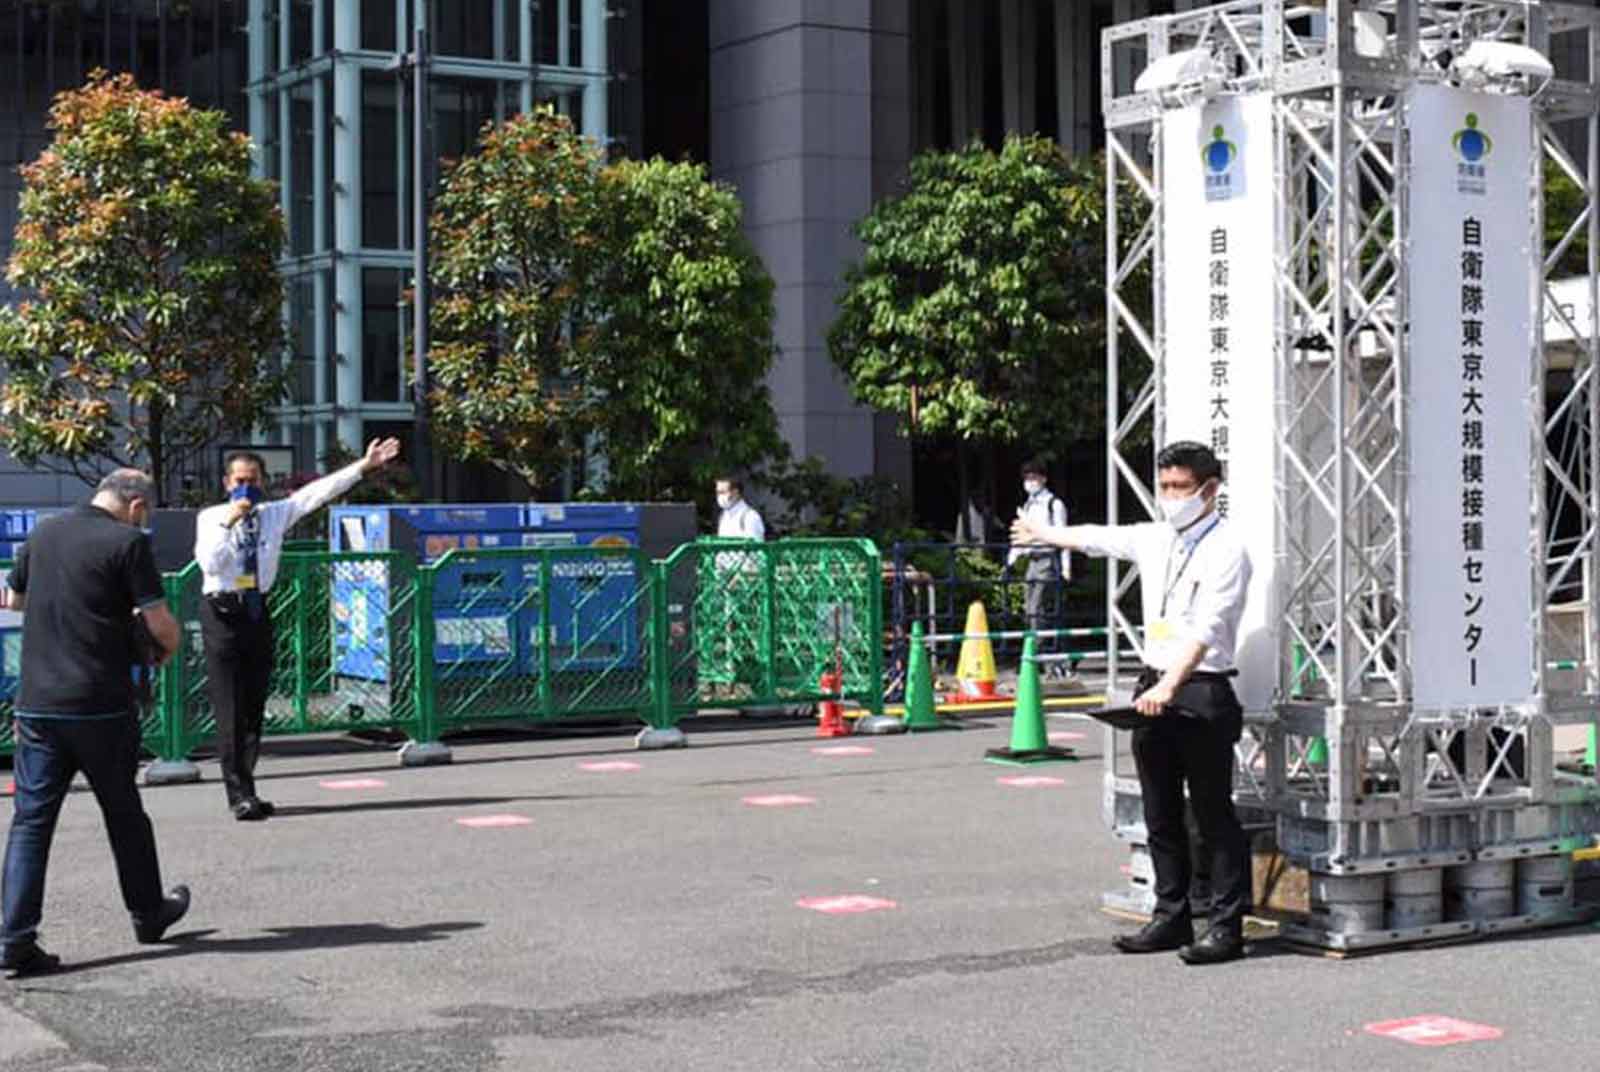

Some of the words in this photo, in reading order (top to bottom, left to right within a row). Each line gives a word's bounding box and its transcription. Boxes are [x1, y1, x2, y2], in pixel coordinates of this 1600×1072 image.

[1461, 217, 1484, 686] 自衛隊東京大規模接種センター
